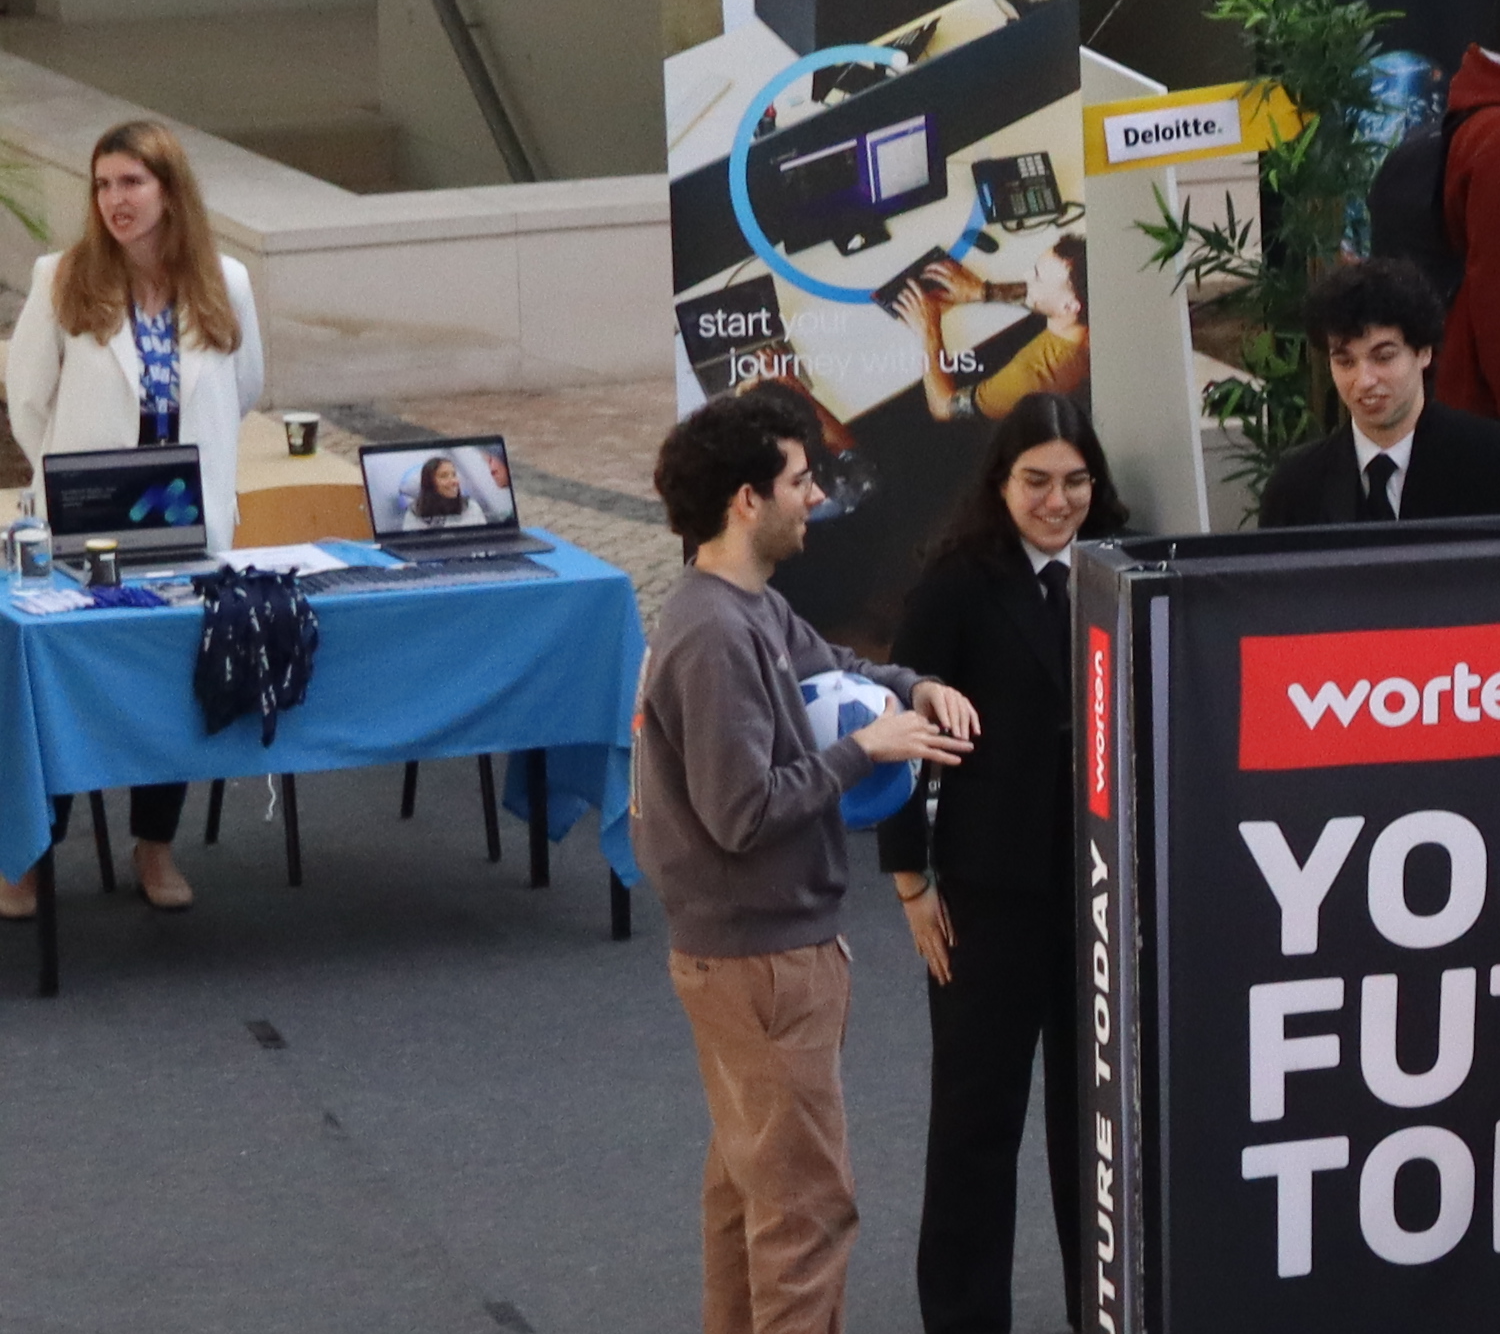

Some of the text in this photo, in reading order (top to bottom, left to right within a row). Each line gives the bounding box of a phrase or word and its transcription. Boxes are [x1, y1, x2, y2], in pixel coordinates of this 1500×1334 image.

[1123, 118, 1224, 147] Deloitte.
[698, 307, 772, 338] start
[728, 347, 848, 386] journey
[938, 348, 985, 374] us.
[1094, 649, 1104, 793] worten
[1089, 838, 1113, 1088] TODAY
